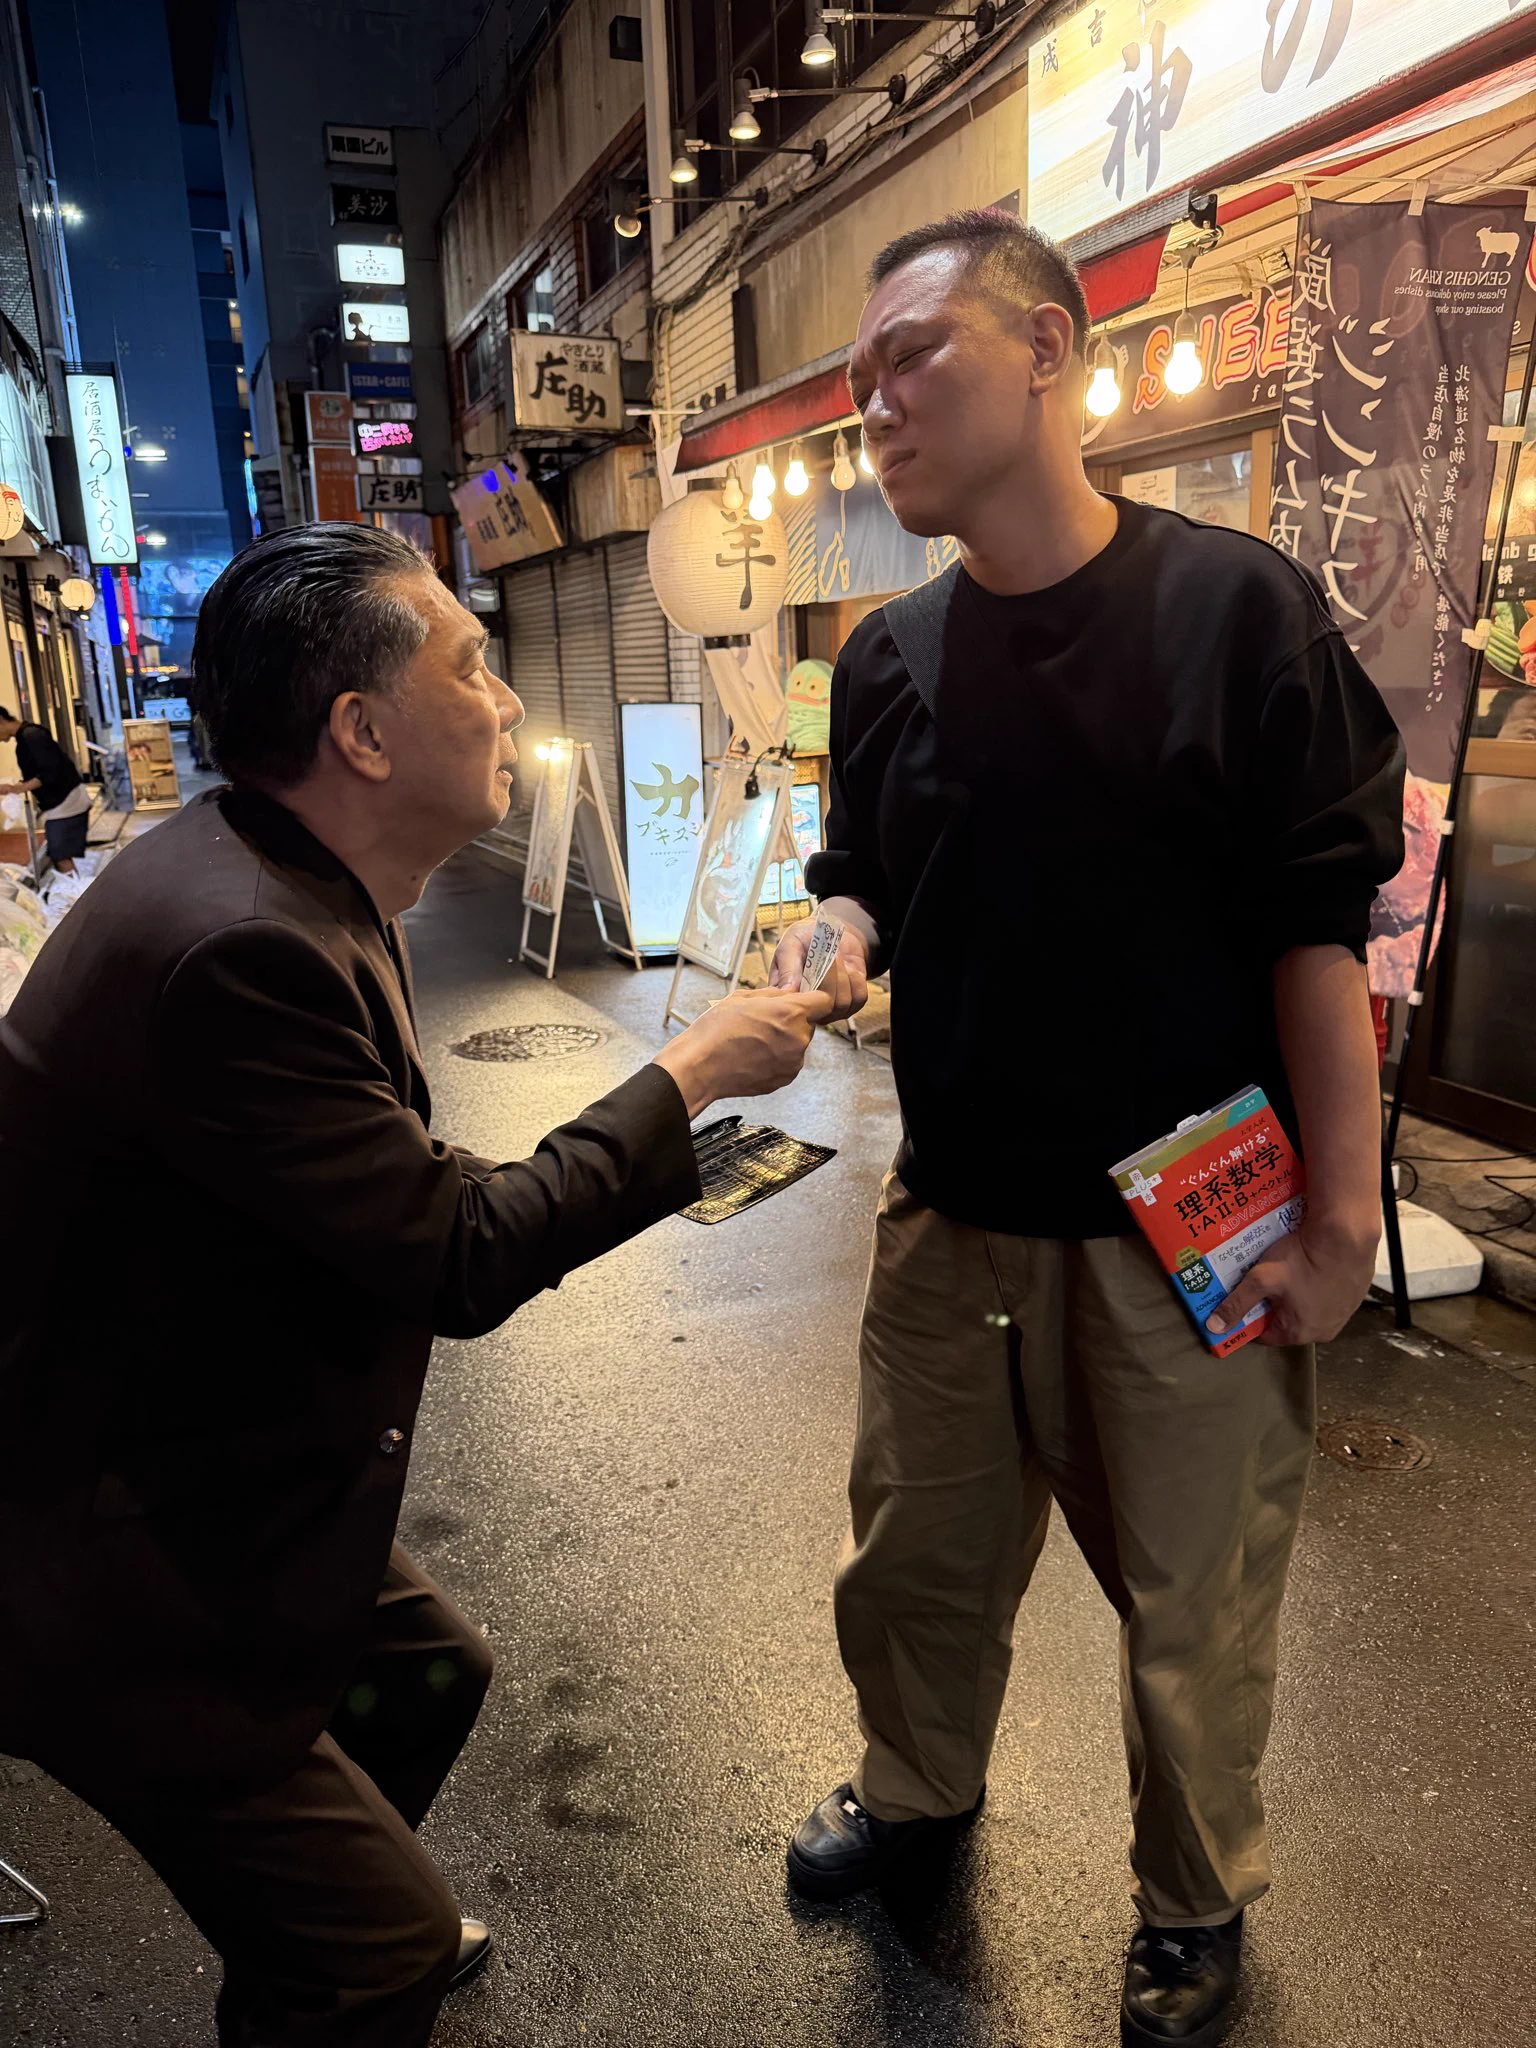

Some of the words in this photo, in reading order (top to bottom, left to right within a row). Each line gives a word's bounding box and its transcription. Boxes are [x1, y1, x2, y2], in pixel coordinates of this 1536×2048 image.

[331, 135, 388, 155] ビル
[559, 342, 605, 358] やきとり
[529, 351, 606, 422] 庄助
[368, 478, 423, 505] 庄助
[716, 508, 776, 611] 羊
[1173, 1142, 1284, 1221] 理系数学
[1181, 1263, 1204, 1280] 理系
